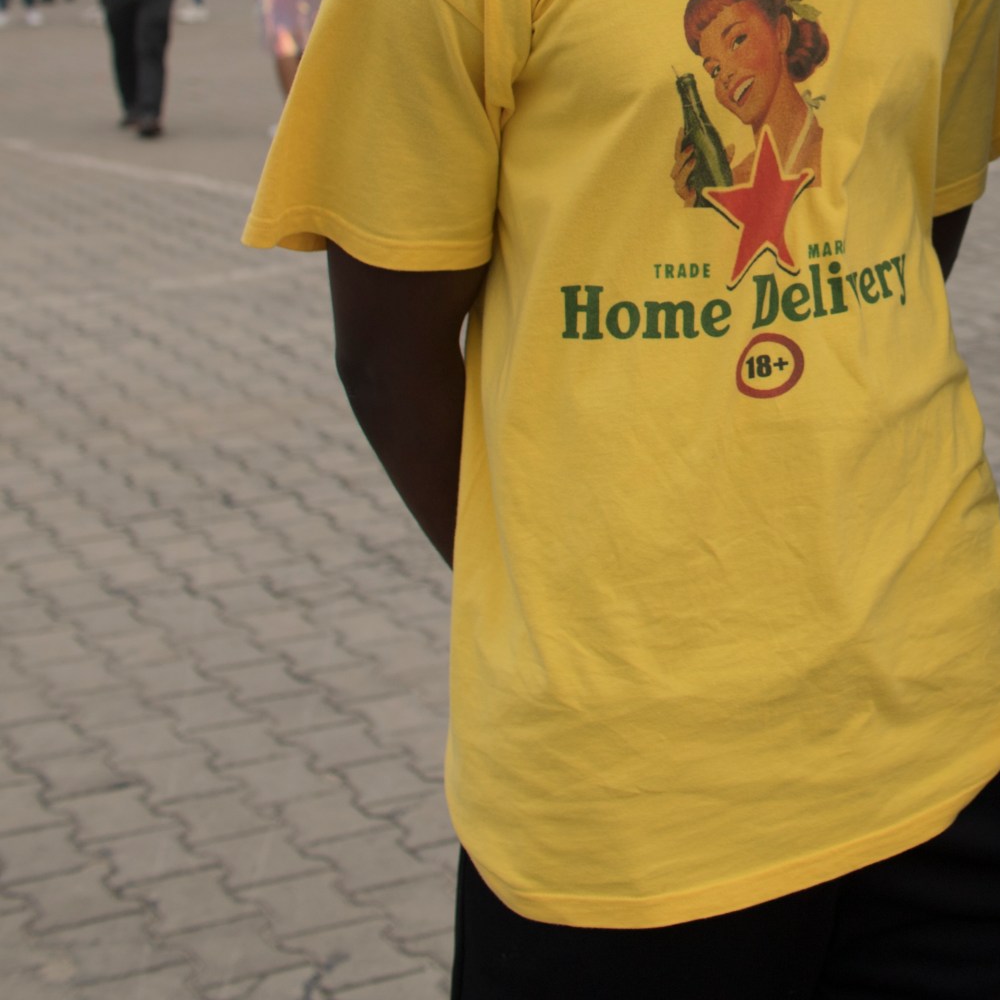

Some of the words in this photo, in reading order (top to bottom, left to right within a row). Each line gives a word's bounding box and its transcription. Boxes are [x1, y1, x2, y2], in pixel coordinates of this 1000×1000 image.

[654, 263, 711, 279] TRADE
[808, 239, 845, 259] MAR
[560, 284, 732, 341] Home
[752, 253, 906, 331] Delivery
[745, 354, 789, 379] 18+
